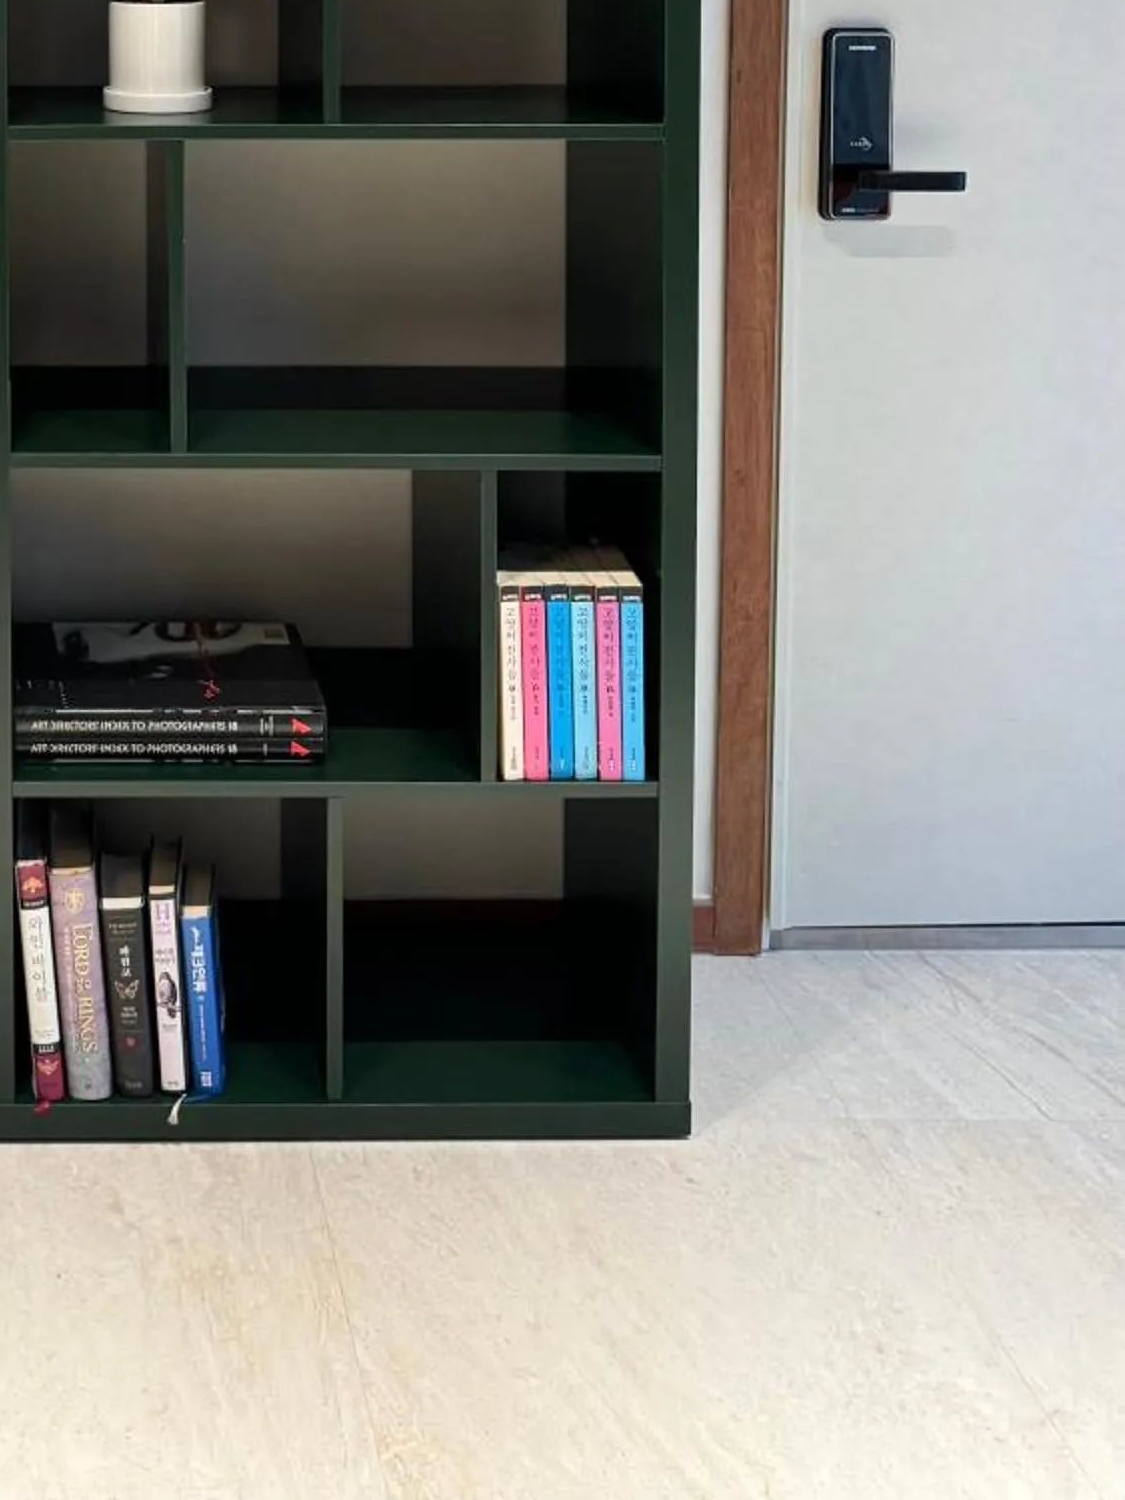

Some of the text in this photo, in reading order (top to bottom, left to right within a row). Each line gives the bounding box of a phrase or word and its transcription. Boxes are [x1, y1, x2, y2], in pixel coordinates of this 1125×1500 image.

[131, 721, 146, 732] TO
[131, 744, 145, 754] TO
[73, 922, 93, 976] LORD
[78, 997, 98, 1053] RINGS
